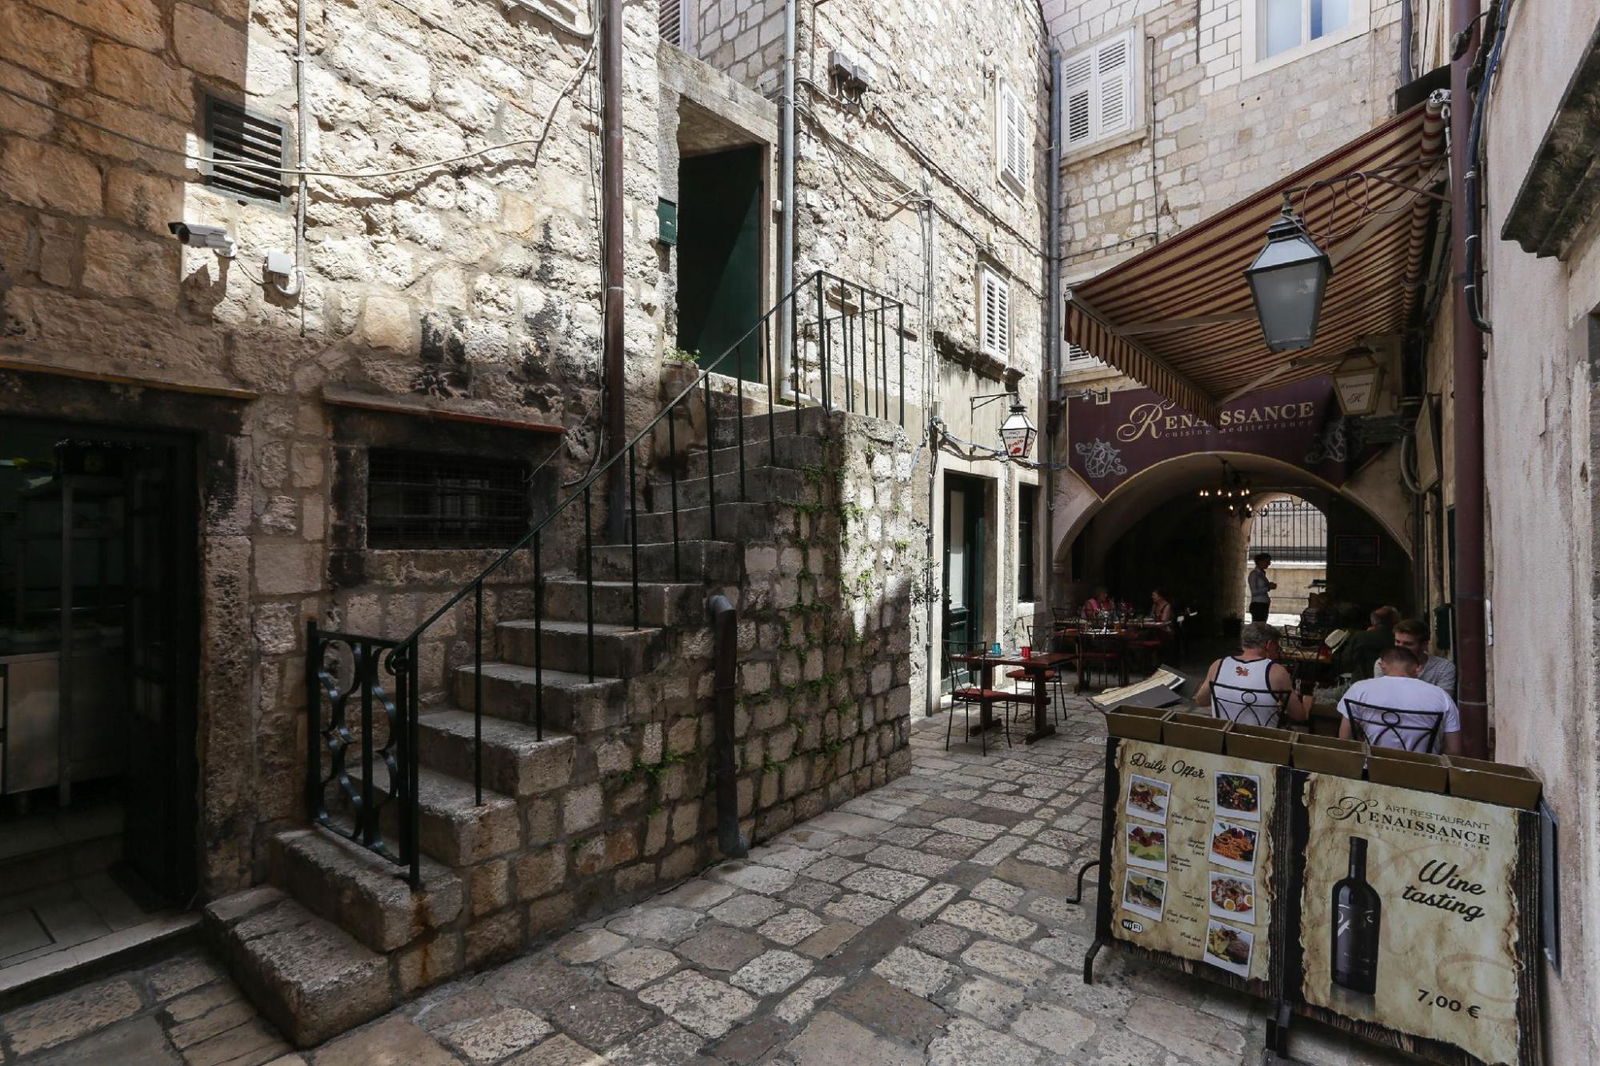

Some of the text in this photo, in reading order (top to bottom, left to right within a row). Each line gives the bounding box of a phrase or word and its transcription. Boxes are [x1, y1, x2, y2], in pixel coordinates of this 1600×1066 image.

[1116, 399, 1314, 442] RENASSANCE
[1130, 752, 1206, 778] Daily Offer
[1326, 796, 1491, 846] RENAISSANCE
[1385, 804, 1490, 830] ART RESTAURANT
[1418, 859, 1486, 896] Wine
[1402, 885, 1485, 922] tasting
[1417, 989, 1481, 1019] 7,00 €
